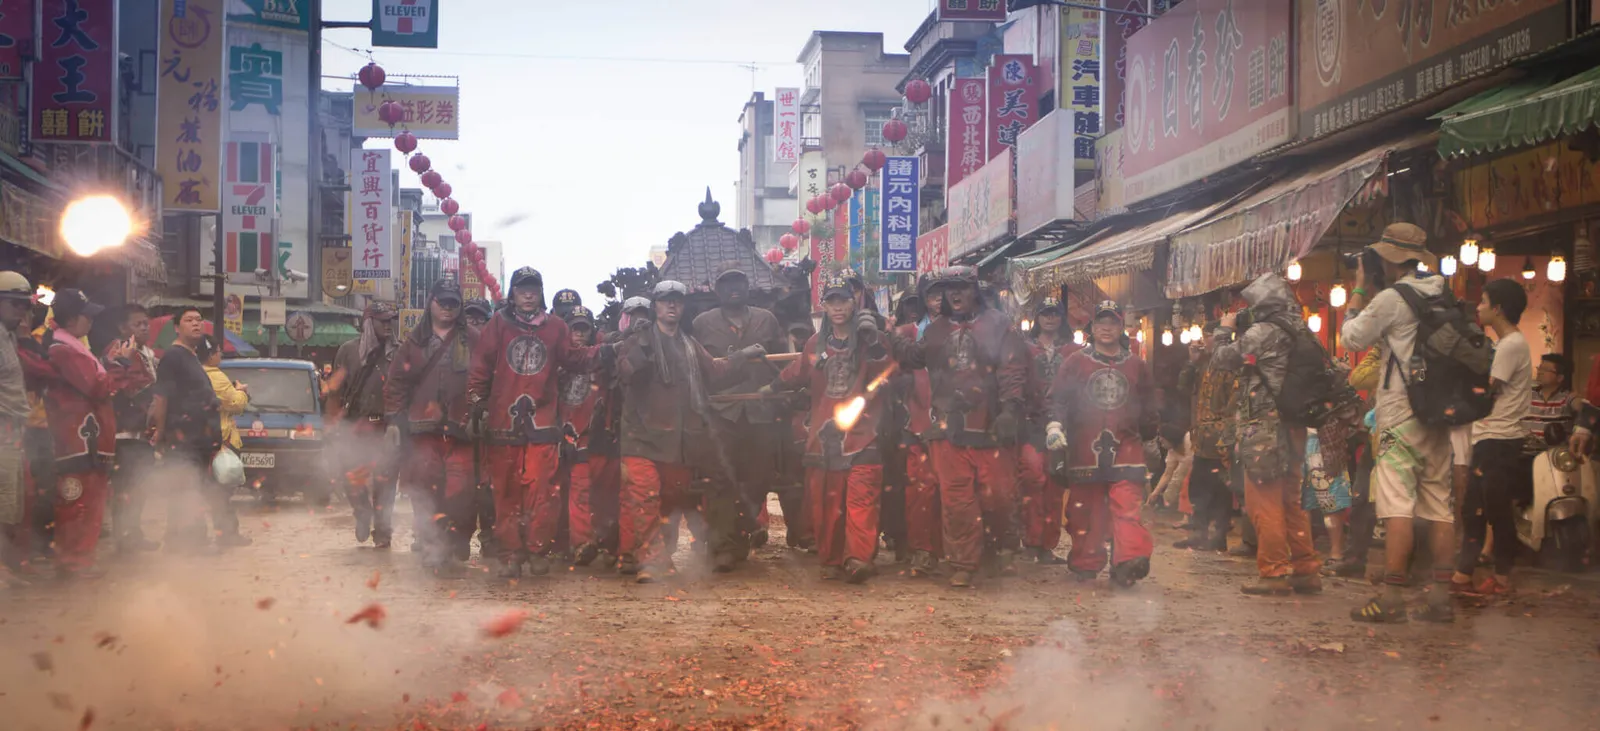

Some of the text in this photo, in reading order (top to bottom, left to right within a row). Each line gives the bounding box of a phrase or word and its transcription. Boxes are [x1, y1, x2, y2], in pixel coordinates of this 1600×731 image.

[379, 99, 454, 125] 益彩券
[359, 151, 384, 268] 宜興百貨行
